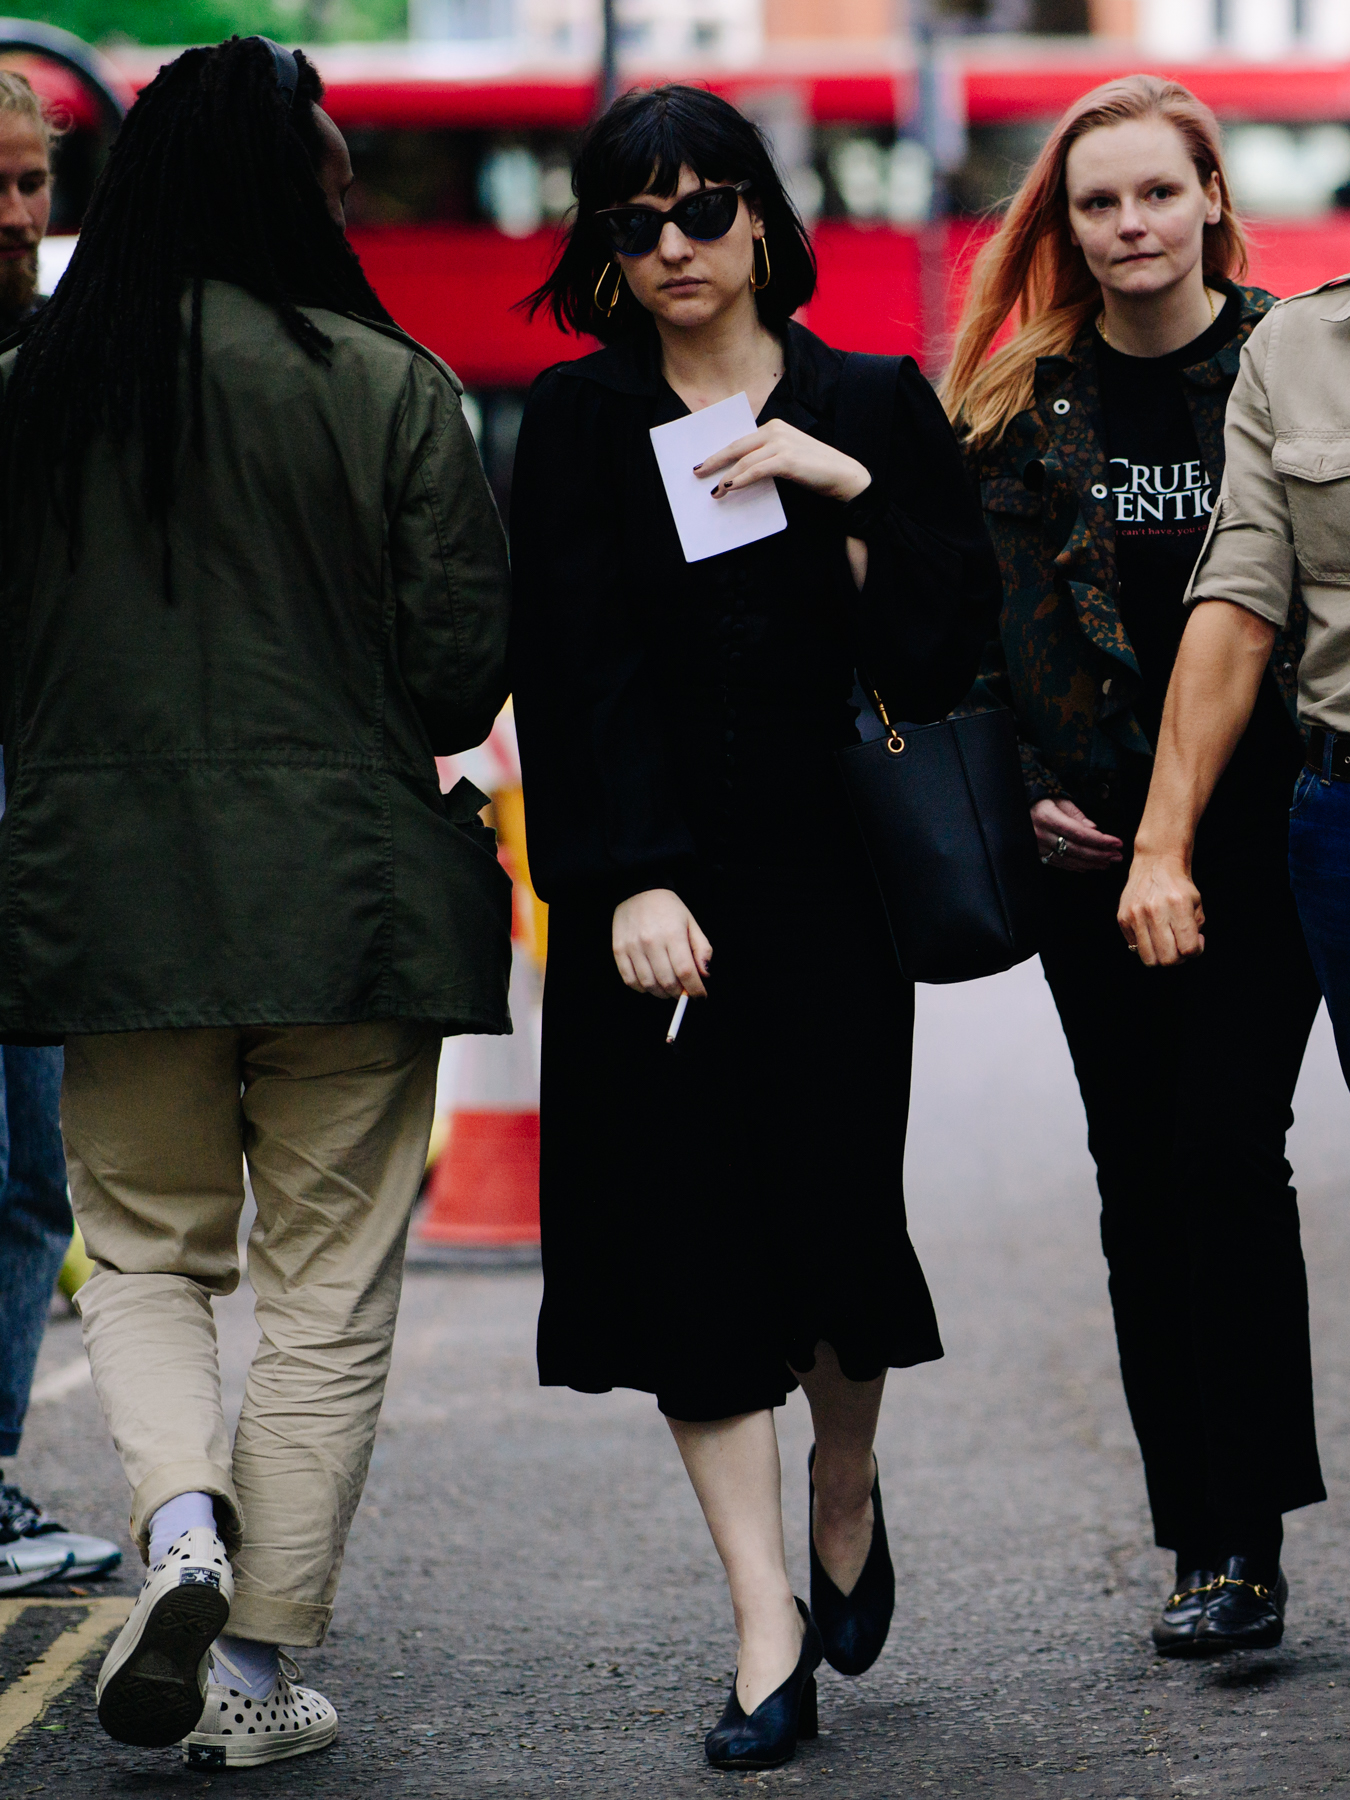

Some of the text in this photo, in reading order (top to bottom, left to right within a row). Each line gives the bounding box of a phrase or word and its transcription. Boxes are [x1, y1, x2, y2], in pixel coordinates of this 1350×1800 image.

[1109, 458, 1211, 494] CRUE
[1177, 526, 1196, 537] you
[1197, 523, 1210, 531] ca
